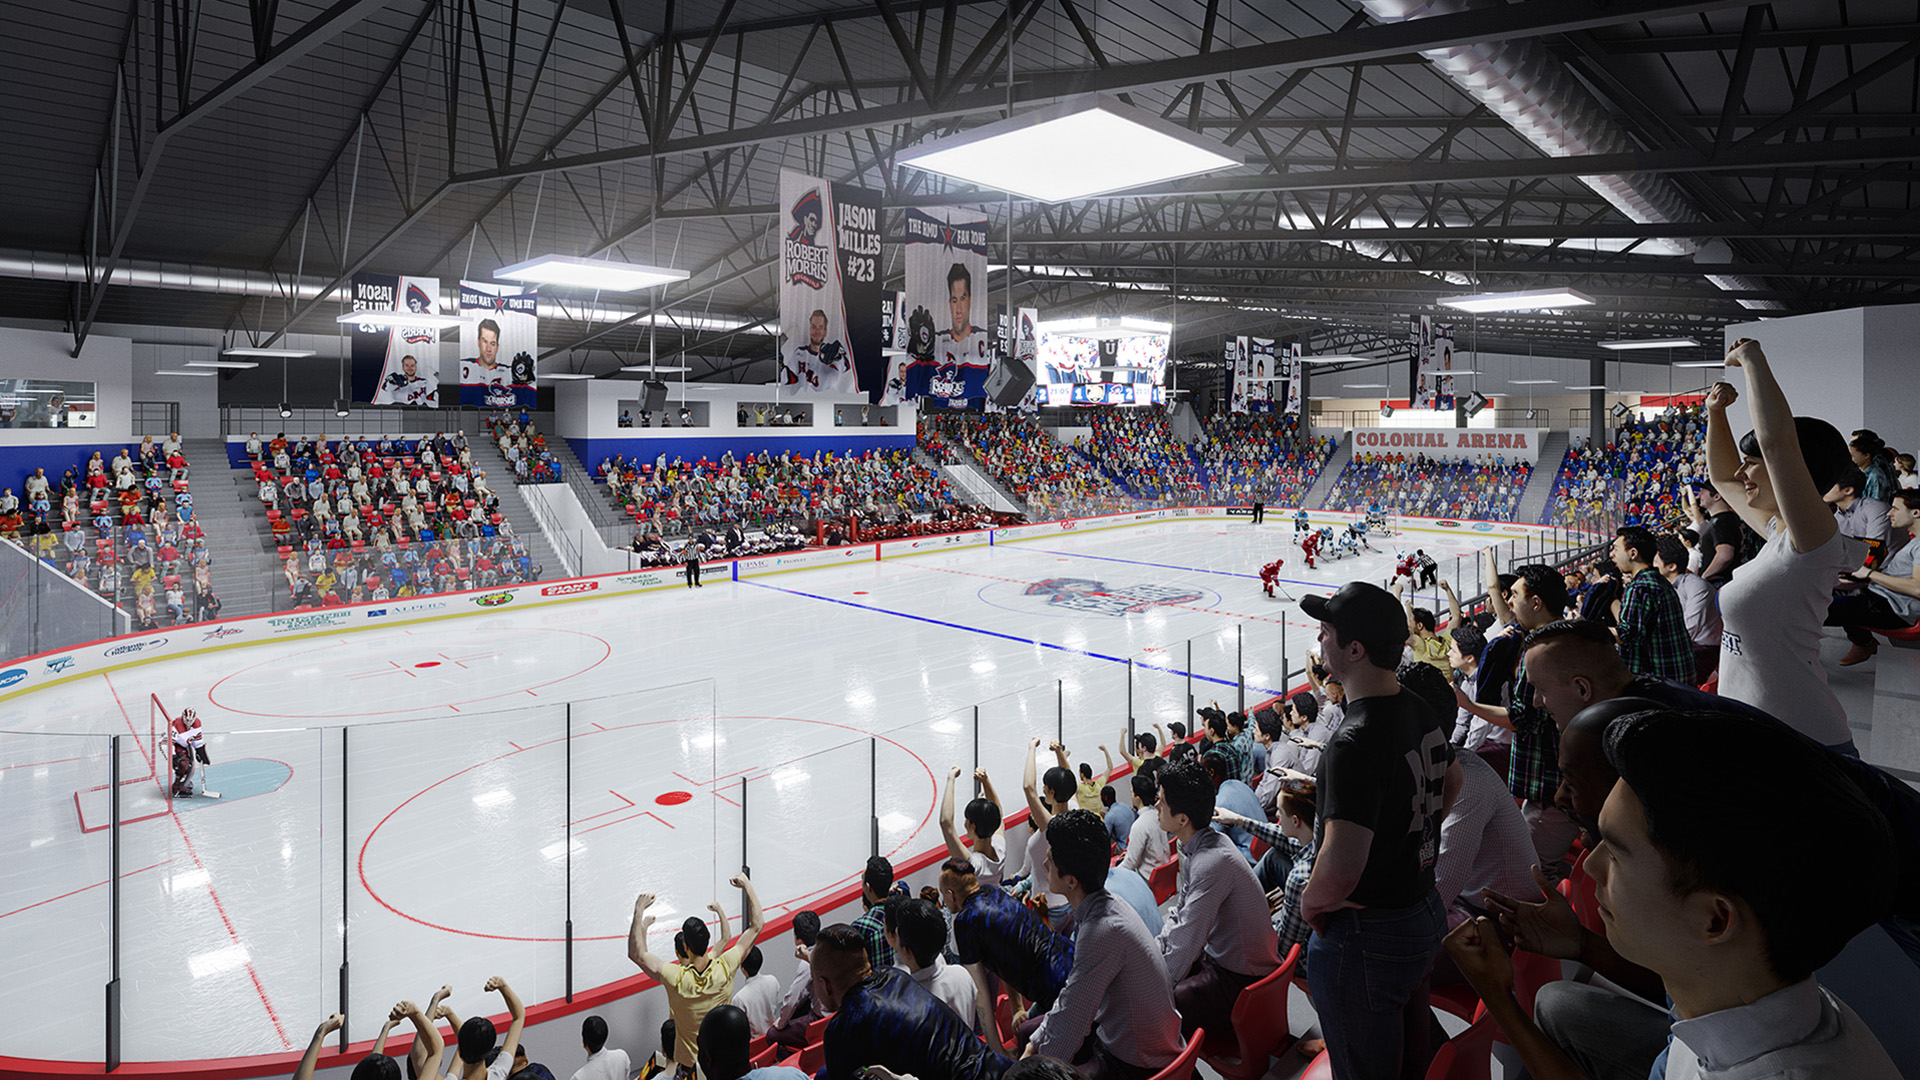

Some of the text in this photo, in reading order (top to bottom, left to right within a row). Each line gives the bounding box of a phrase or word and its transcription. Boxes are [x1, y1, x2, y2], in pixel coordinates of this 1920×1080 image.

[837, 203, 876, 231] JASON
[838, 228, 881, 256] MILLES
[908, 218, 921, 235] THE
[922, 221, 938, 239] RMU
[957, 229, 970, 245] FAN
[786, 239, 829, 263] ROBERT
[786, 258, 828, 283] MORRIS
[847, 255, 875, 282] #23
[1038, 388, 1047, 401] 2
[1074, 388, 1083, 400] 1
[1125, 387, 1133, 400] 2
[1356, 432, 1528, 449] COLONIAL ARENA
